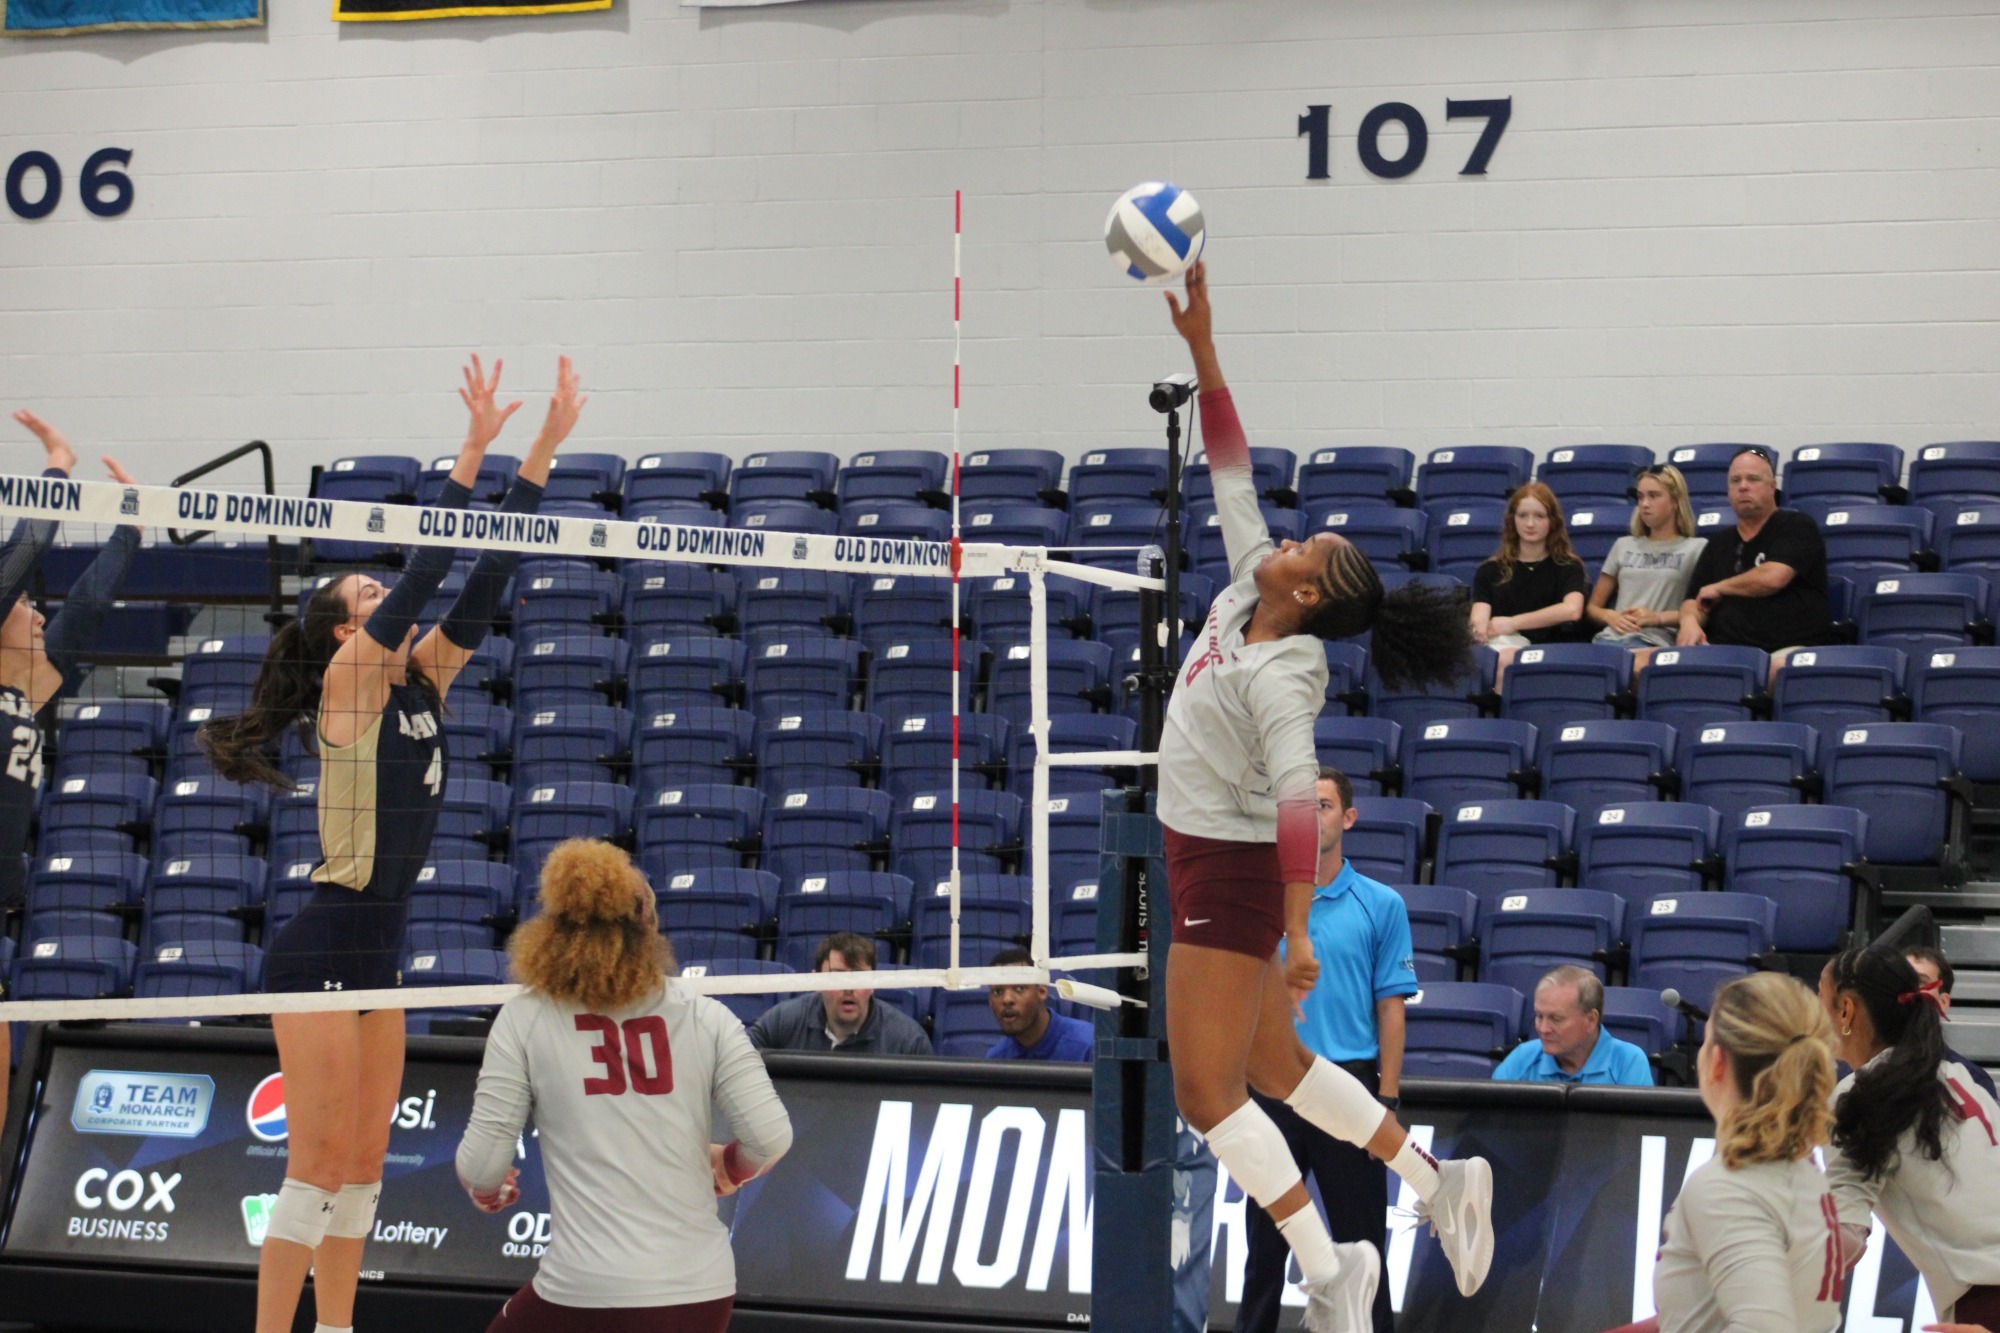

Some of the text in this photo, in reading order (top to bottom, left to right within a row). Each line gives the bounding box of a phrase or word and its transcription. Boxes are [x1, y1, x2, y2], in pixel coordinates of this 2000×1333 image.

[1298, 95, 1512, 180] 107
[5, 147, 135, 219] 06
[178, 490, 333, 529] OLD DOMINION
[418, 509, 560, 545] OLD DOMINION
[636, 525, 765, 558] OLD DOMINION
[834, 538, 951, 567] OLD DOMINION
[423, 747, 442, 797] 4
[574, 1013, 674, 1096] 30
[119, 1103, 196, 1118] MONARCH
[127, 1084, 199, 1105] TEAM
[87, 1116, 190, 1129] CORPORATE PARTNER
[75, 1167, 182, 1213] COX
[67, 1216, 169, 1242] BUSINESS
[373, 1219, 448, 1249] Lottery
[508, 1211, 552, 1243] OD
[502, 1242, 531, 1257] OLD
